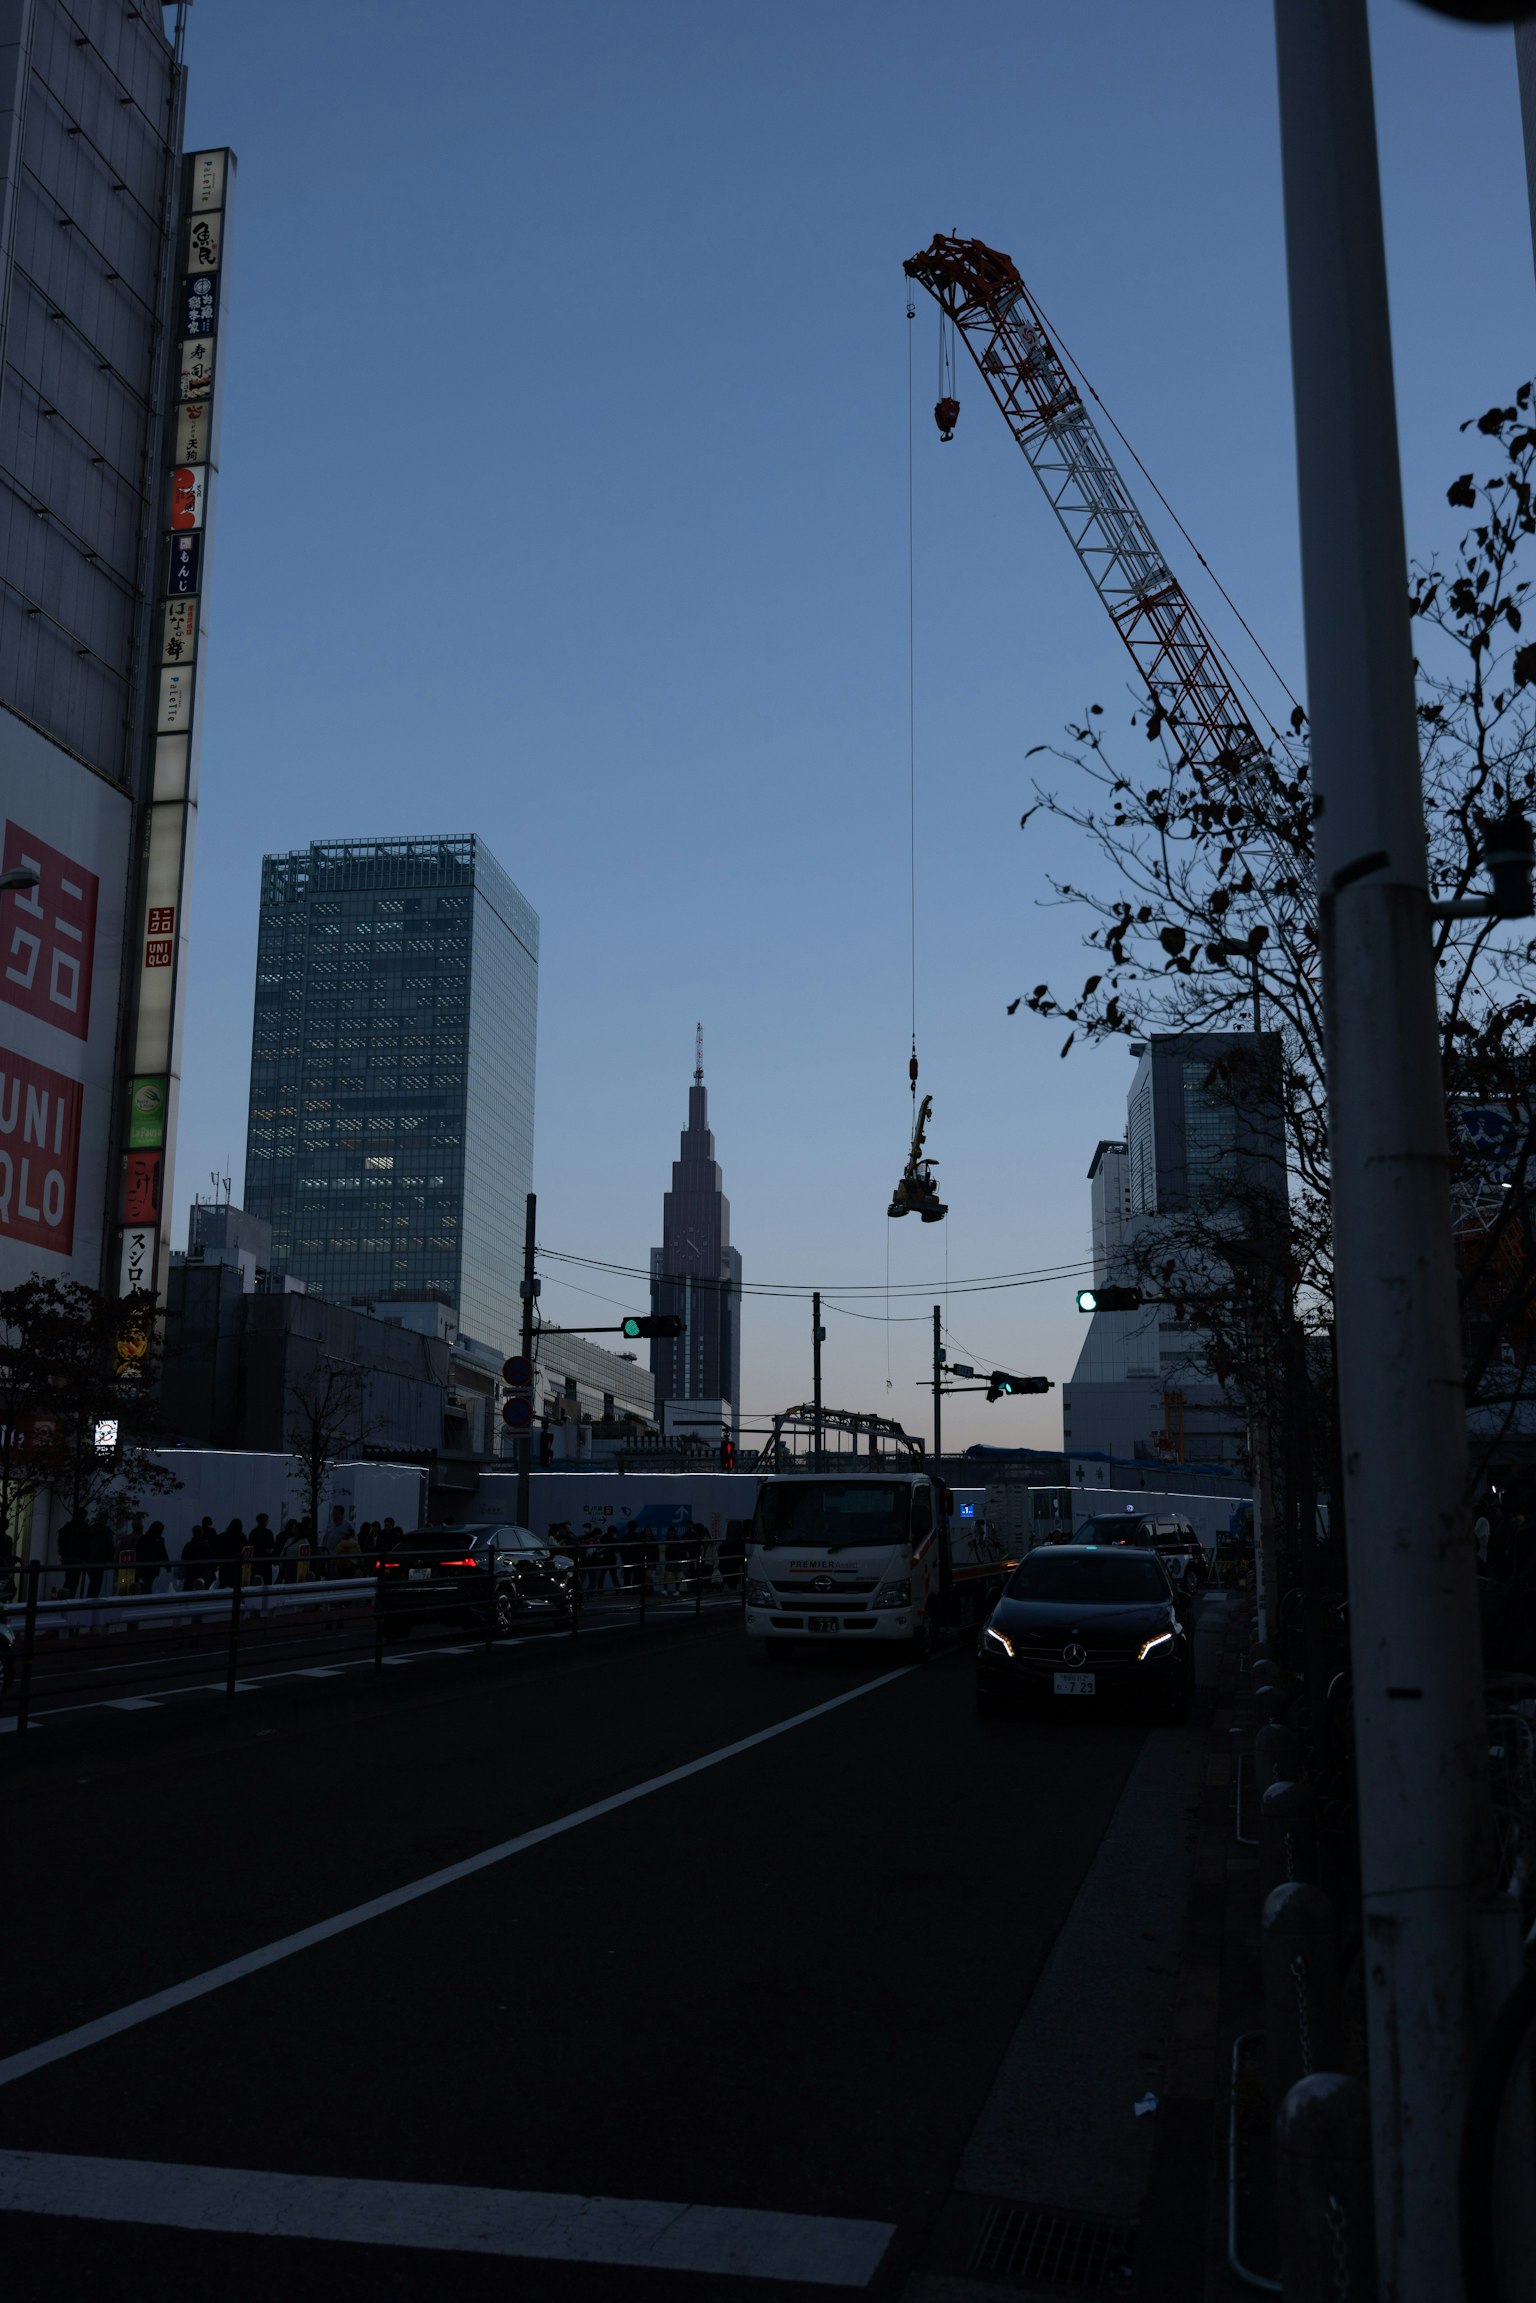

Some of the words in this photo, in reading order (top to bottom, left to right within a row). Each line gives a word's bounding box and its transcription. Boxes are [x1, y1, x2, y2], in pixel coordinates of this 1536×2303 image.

[193, 222, 216, 265] 魚民
[190, 343, 206, 379] 寿司
[186, 439, 198, 461] 天狗
[178, 551, 190, 592] もんじ
[165, 602, 187, 661] はなの舞
[149, 943, 168, 954] UNI
[148, 954, 169, 967] QLO
[131, 1127, 140, 1138] La
[790, 1560, 834, 1568] PREMIER
